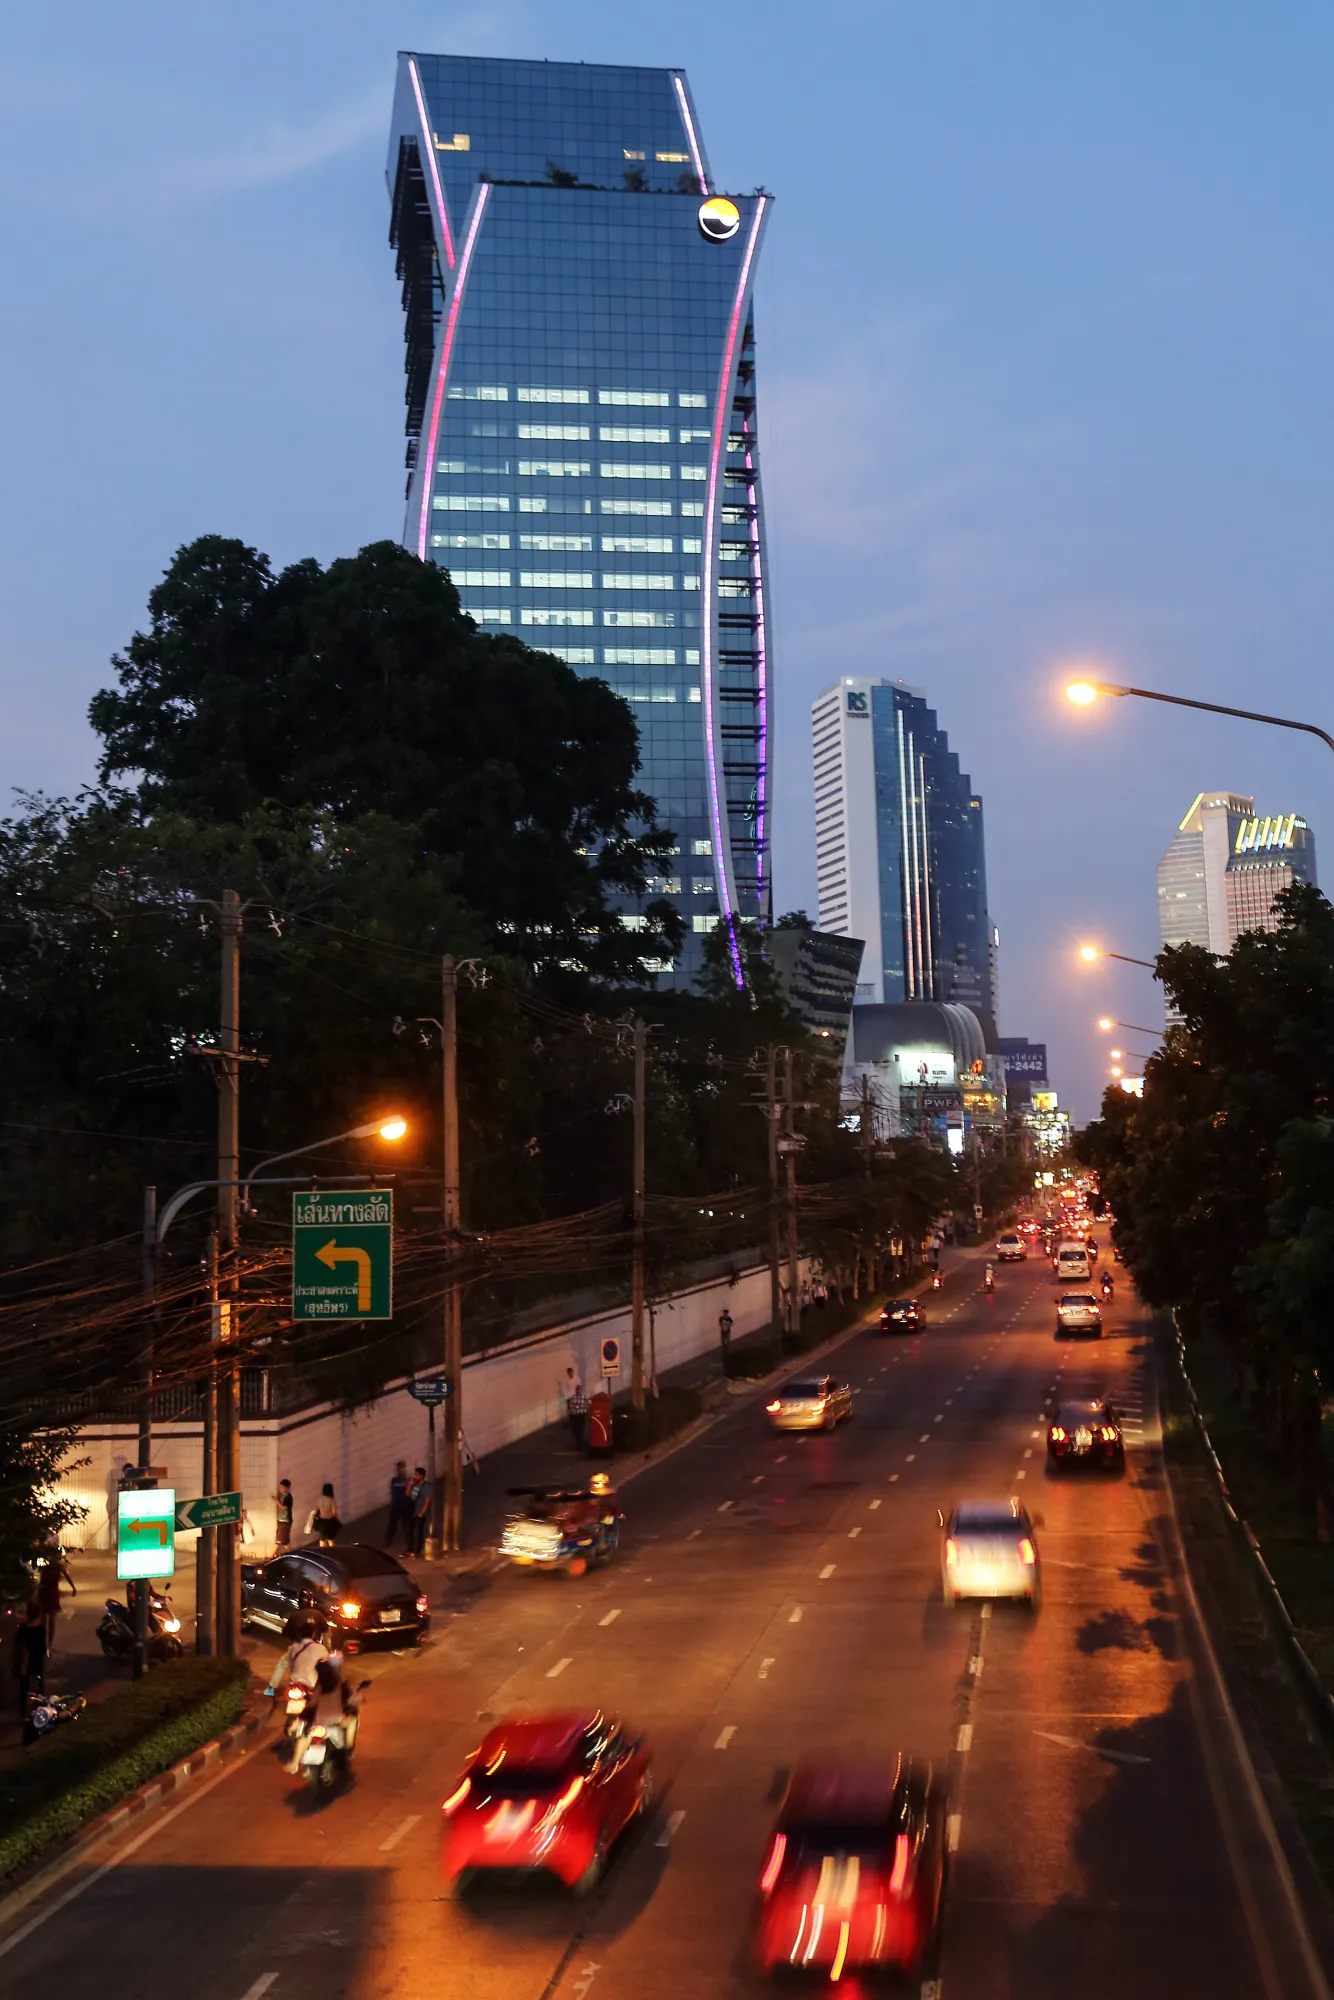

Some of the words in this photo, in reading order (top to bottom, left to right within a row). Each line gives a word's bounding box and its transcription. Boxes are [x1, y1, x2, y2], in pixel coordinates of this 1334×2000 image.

[847, 691, 867, 712] RS
[297, 1195, 389, 1224] เส้นทางลัด
